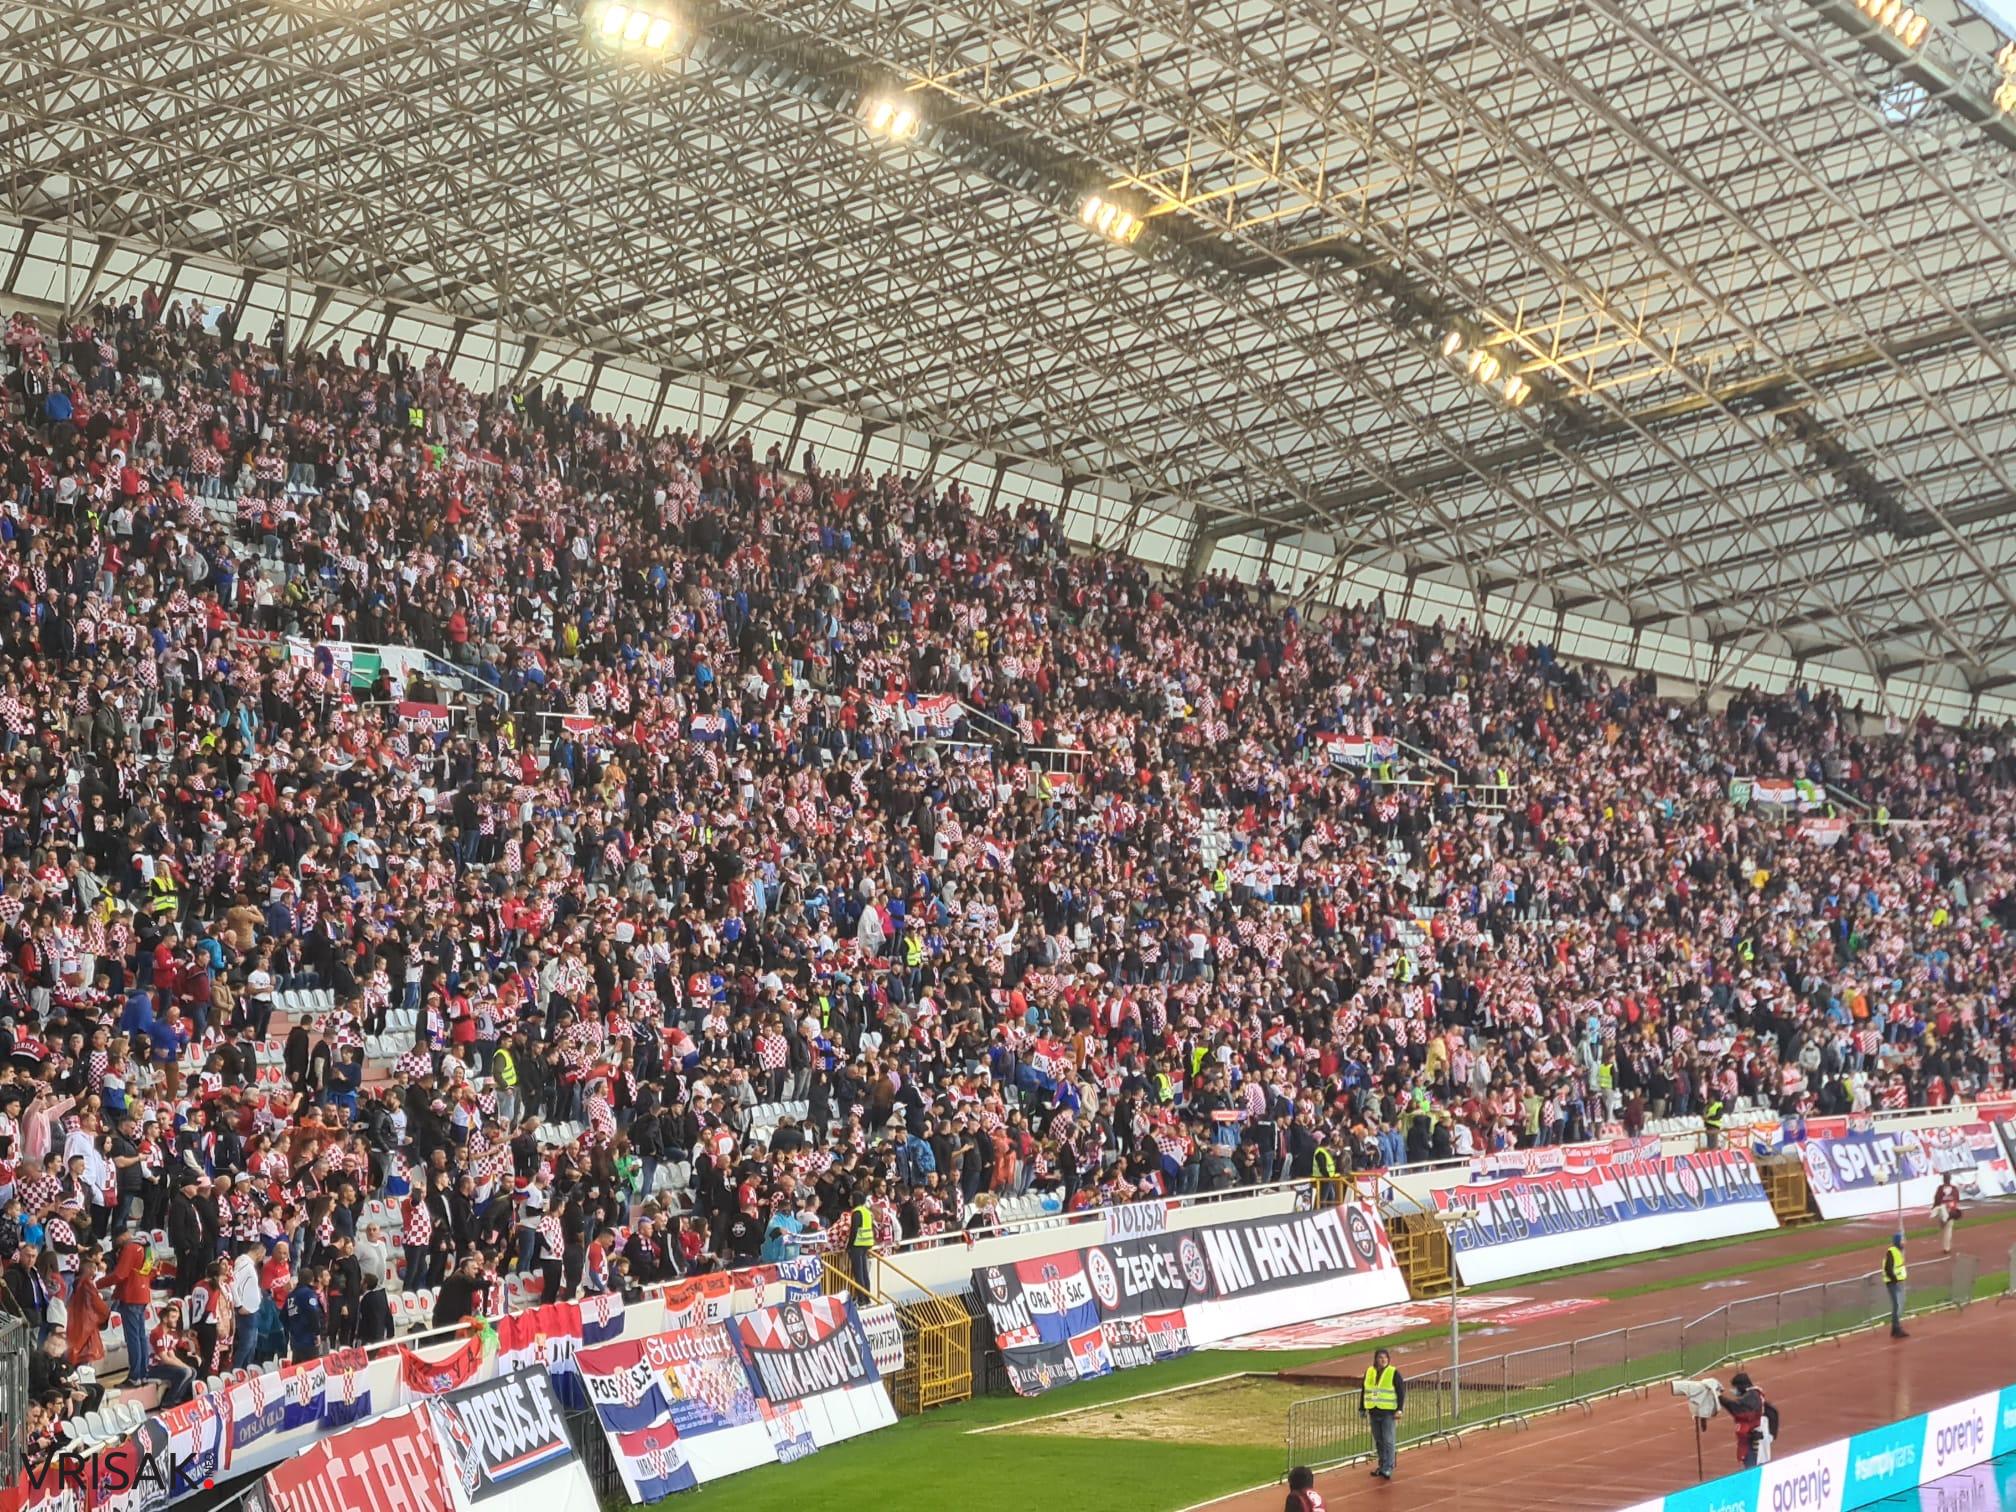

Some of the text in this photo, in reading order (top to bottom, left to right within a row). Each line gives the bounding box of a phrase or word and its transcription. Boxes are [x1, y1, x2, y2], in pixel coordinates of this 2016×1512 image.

[1610, 1151, 1764, 1215] VUKOVAR
[1831, 1138, 1899, 1183] SPLIT
[1113, 1202, 1164, 1236] TOLISA
[1114, 1243, 1184, 1297] ŽEPČE
[1202, 1209, 1356, 1295] MI HRVATI
[987, 1296, 1032, 1335] PUNAT
[646, 1327, 732, 1365] Stuttgart
[754, 1325, 866, 1402] MIKANOVCI
[456, 1374, 566, 1481] POSUŠJE
[1937, 1409, 1984, 1466] gorenje
[1772, 1459, 1832, 1512] gorenje
